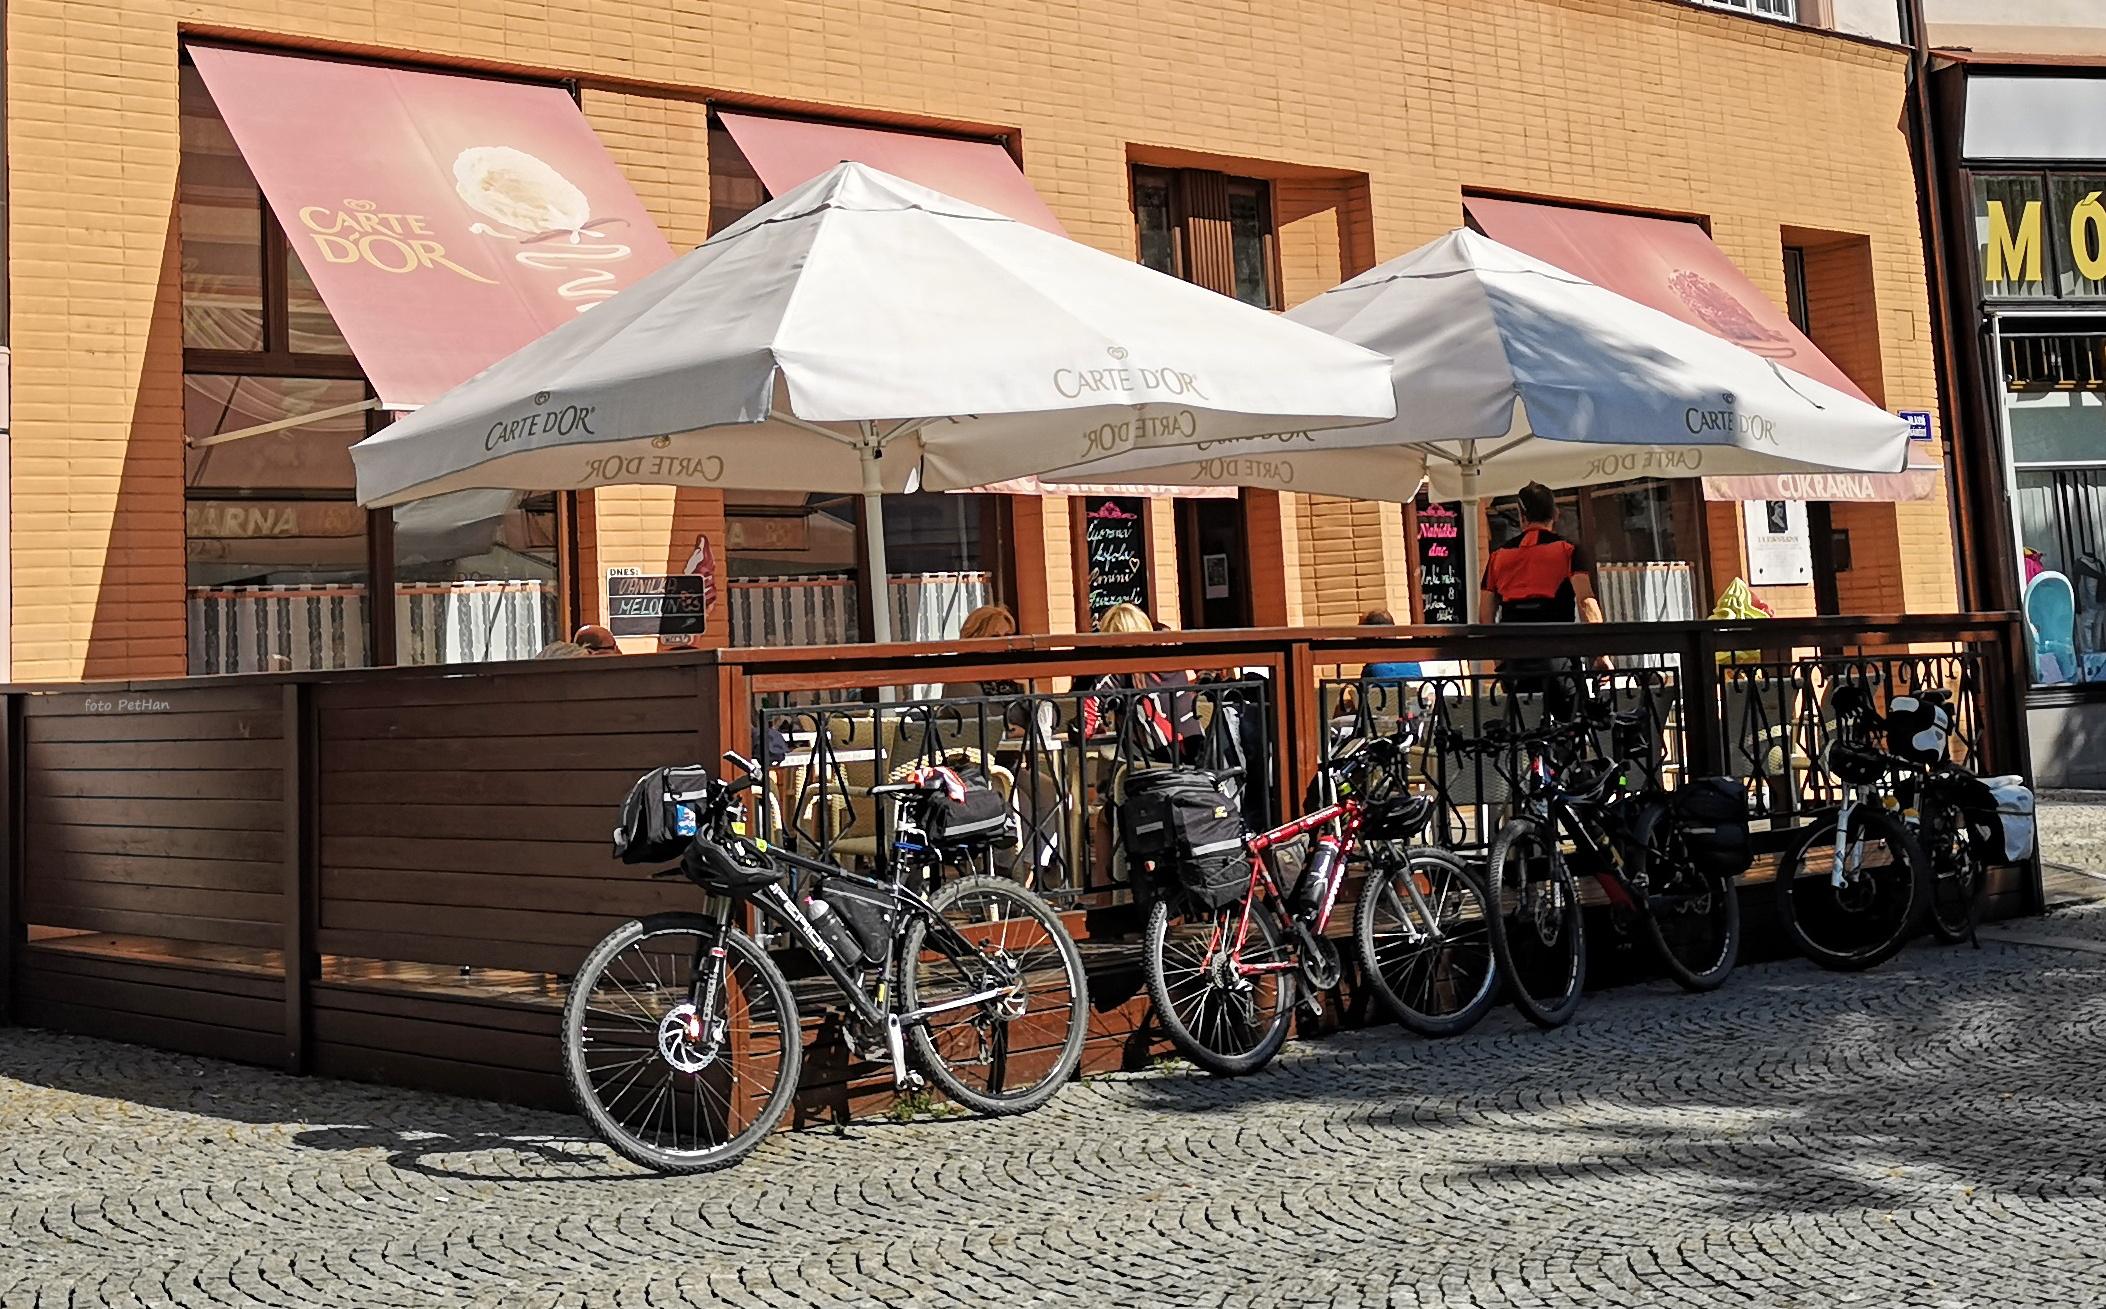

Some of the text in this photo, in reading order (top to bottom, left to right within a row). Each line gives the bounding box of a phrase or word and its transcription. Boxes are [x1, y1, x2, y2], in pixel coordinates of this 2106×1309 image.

[299, 206, 435, 238] CARTE
[310, 232, 500, 284] D'OR
[1053, 367, 1209, 400] CARTE D'OR
[485, 413, 541, 451] CARTE
[1685, 407, 1734, 434] CARTE
[609, 568, 639, 576] DNES:
[618, 598, 680, 615] MELOUN
